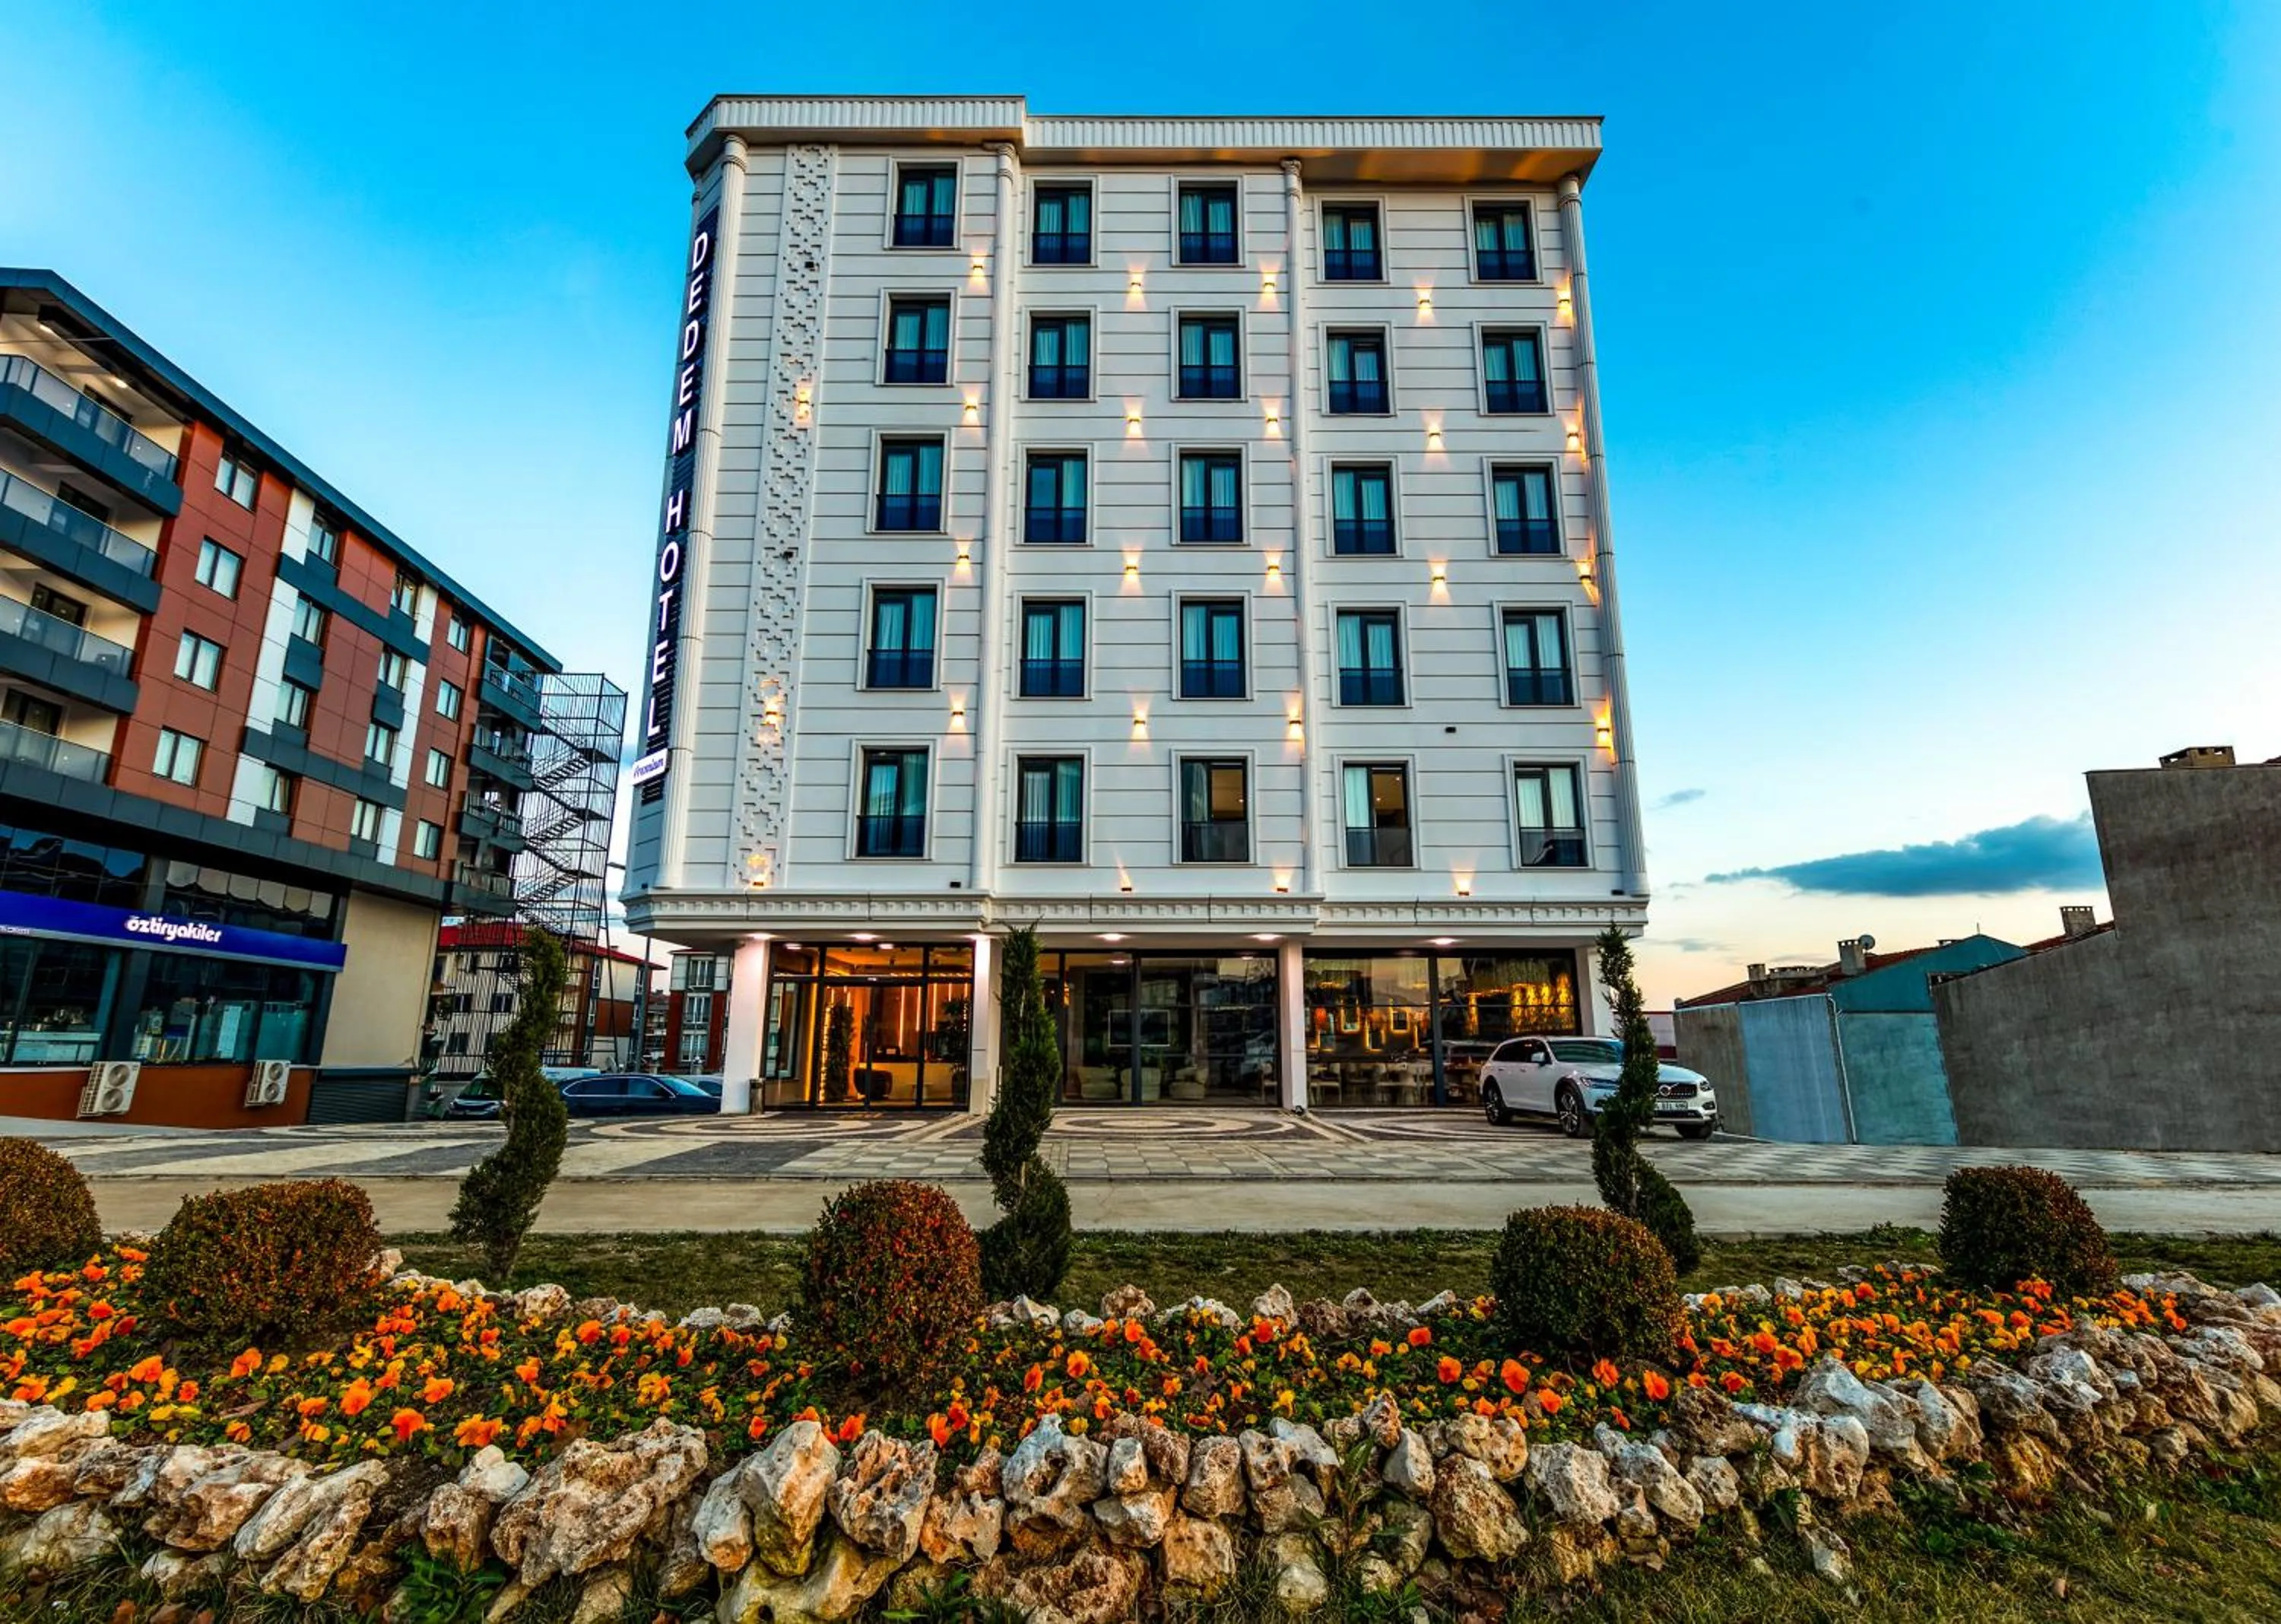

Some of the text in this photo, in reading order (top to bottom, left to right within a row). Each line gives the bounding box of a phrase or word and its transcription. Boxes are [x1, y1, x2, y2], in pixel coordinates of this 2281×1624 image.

[646, 231, 708, 738] DEDEM HOTEL
[125, 915, 222, 942] öztiryakiler
